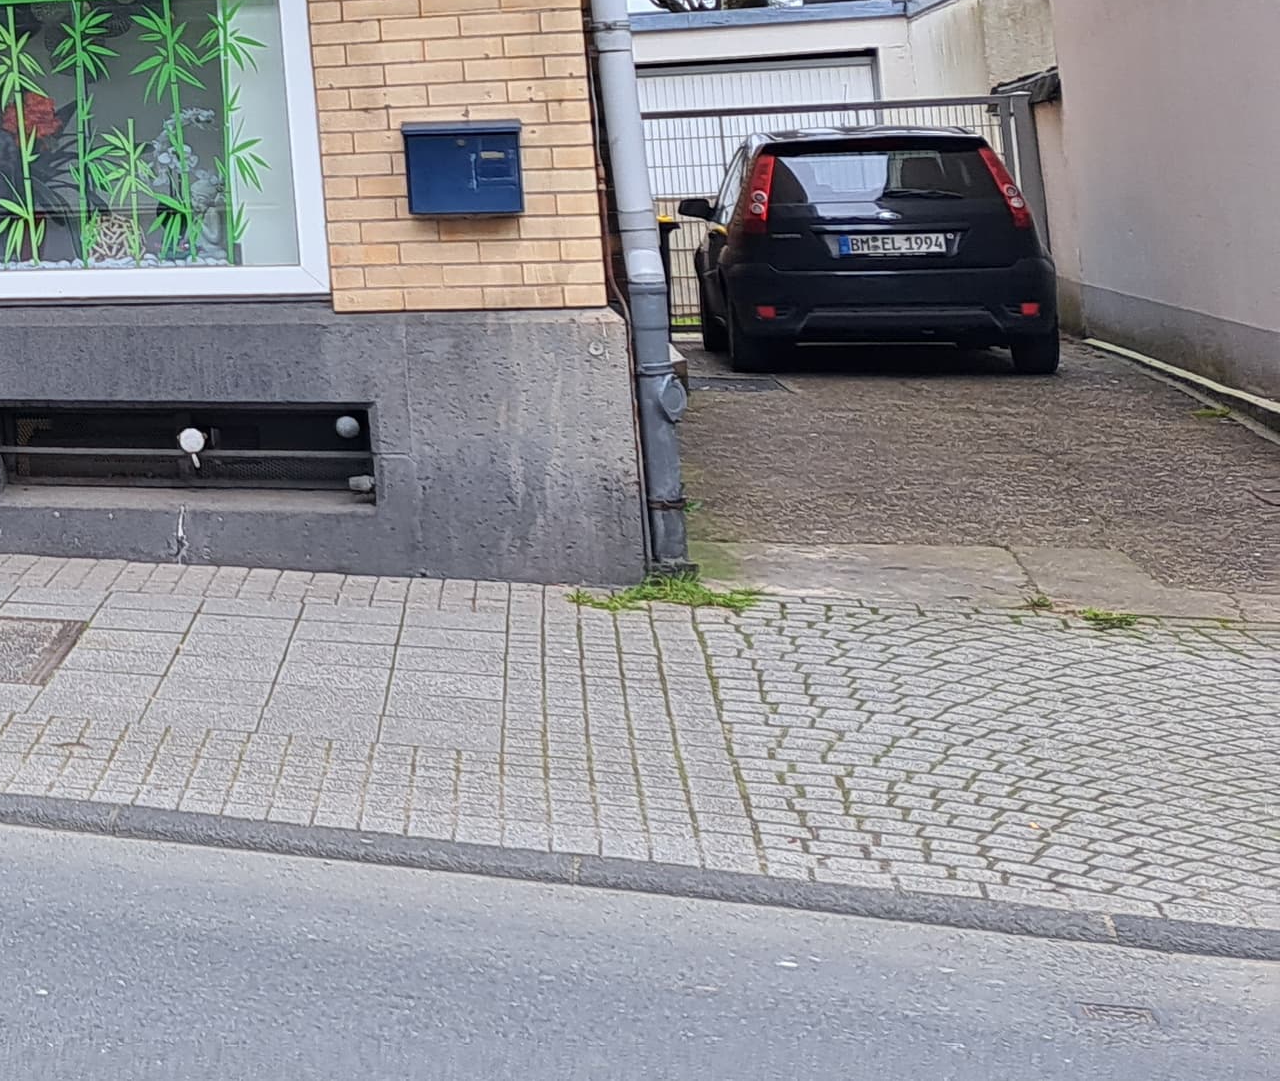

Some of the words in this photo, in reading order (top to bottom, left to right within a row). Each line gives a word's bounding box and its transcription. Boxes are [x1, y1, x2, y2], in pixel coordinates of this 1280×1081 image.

[851, 239, 871, 252] BM
[882, 237, 900, 251] EL
[904, 236, 943, 250] 1994
